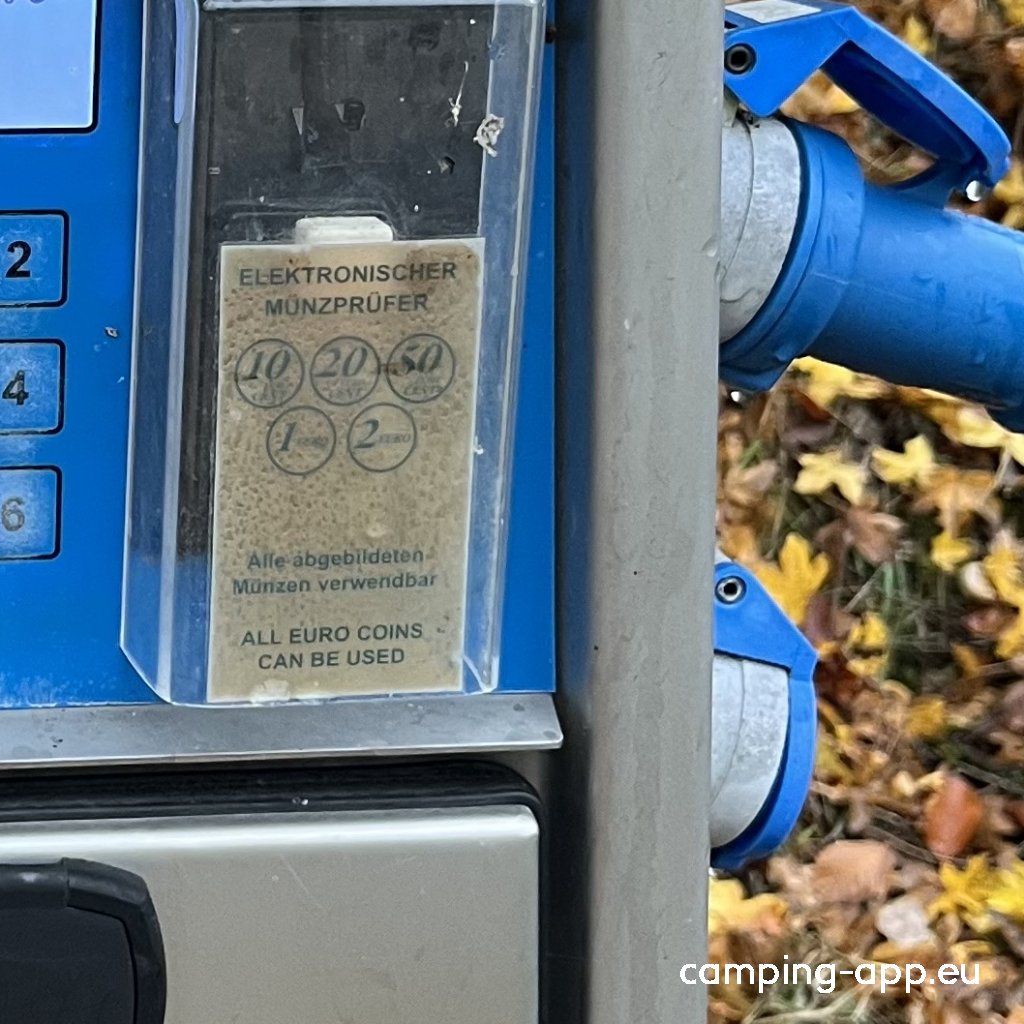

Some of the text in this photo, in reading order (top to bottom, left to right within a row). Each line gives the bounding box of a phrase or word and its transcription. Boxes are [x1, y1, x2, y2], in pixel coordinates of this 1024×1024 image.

[5, 241, 32, 278] 2
[240, 262, 457, 286] ELEKTRONISCHER
[265, 291, 429, 316] MÜNZPRÜFER
[241, 348, 292, 381] 10
[314, 346, 369, 378] 20
[2, 369, 29, 406] 4
[279, 422, 297, 452] 1
[354, 418, 380, 449] 2
[0, 497, 26, 532] 6
[247, 548, 424, 570] Alle abgebildeten
[318, 573, 437, 592] verwendbar
[241, 623, 423, 646] ALL EURO COINS
[258, 648, 405, 669] CAN BE USED
